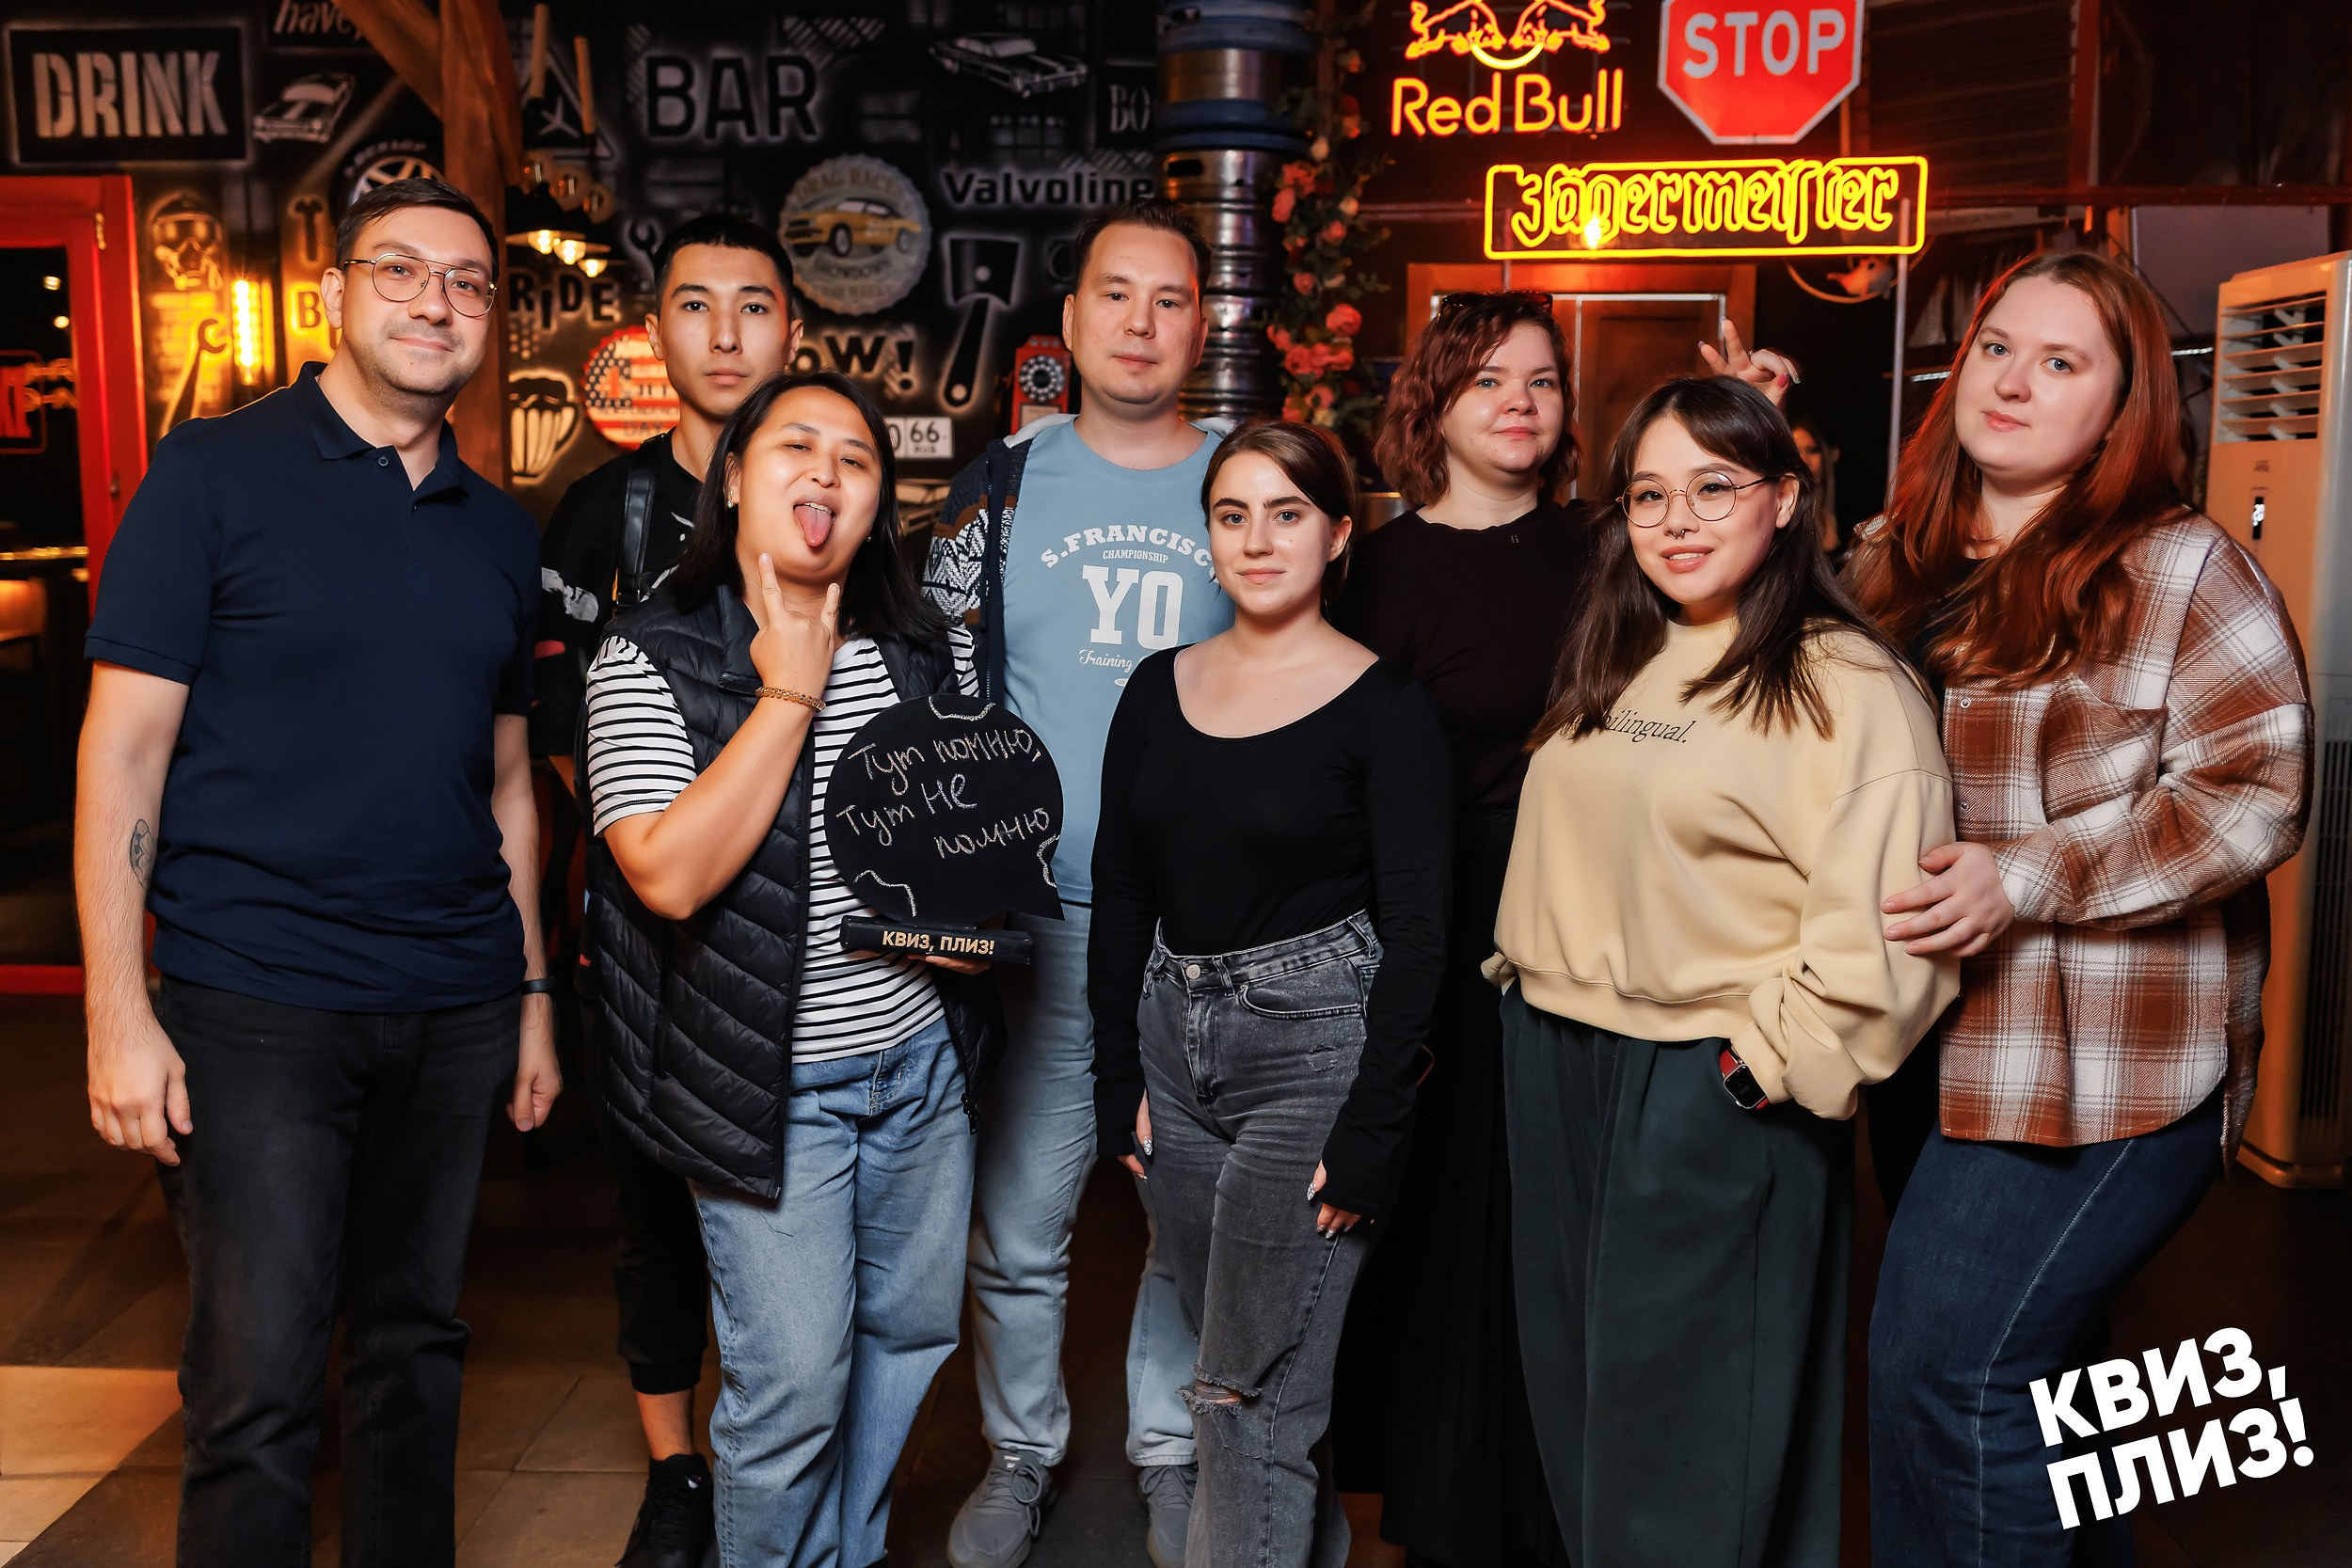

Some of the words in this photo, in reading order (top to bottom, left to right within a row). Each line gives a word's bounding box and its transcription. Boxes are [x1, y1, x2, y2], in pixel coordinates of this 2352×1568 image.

[1681, 9, 1846, 79] STOP
[32, 51, 228, 139] DRINK
[647, 55, 817, 138] BAR
[1391, 71, 1502, 136] Red
[1514, 68, 1624, 133] Bull
[946, 172, 1152, 203] Valvoline
[509, 273, 614, 327] RIDE
[1103, 549, 1168, 563] CHAMPIONSHIP
[1082, 564, 1183, 649] YO
[1079, 649, 1133, 673] Training
[848, 742, 925, 796] Тут
[835, 804, 915, 847] Тут
[933, 807, 1050, 859] помню
[882, 929, 933, 950] КВИЗ,
[940, 935, 995, 955] ПЛИЗ!
